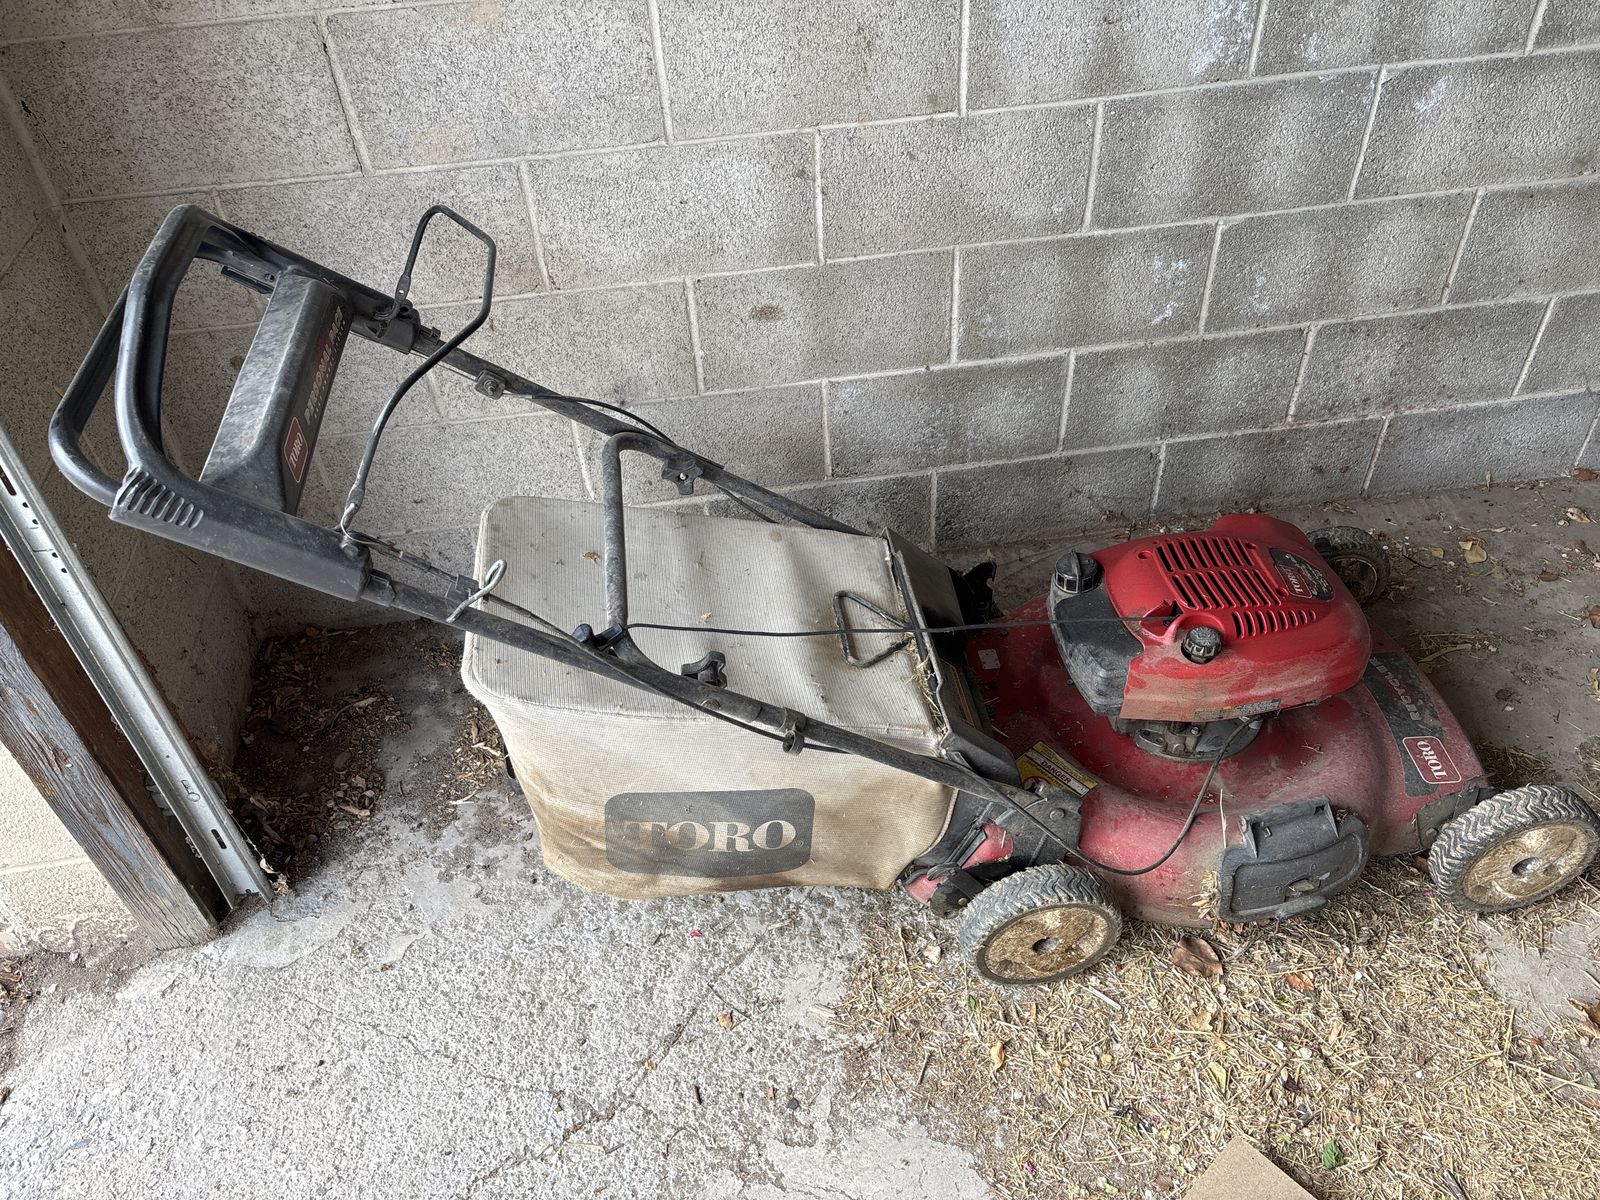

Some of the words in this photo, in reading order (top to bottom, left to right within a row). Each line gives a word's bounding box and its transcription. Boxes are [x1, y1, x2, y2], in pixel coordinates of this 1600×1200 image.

[289, 432, 304, 468] TORO
[1041, 760, 1072, 784] DANGER
[1416, 740, 1448, 779] TORO
[624, 819, 797, 853] TORO
